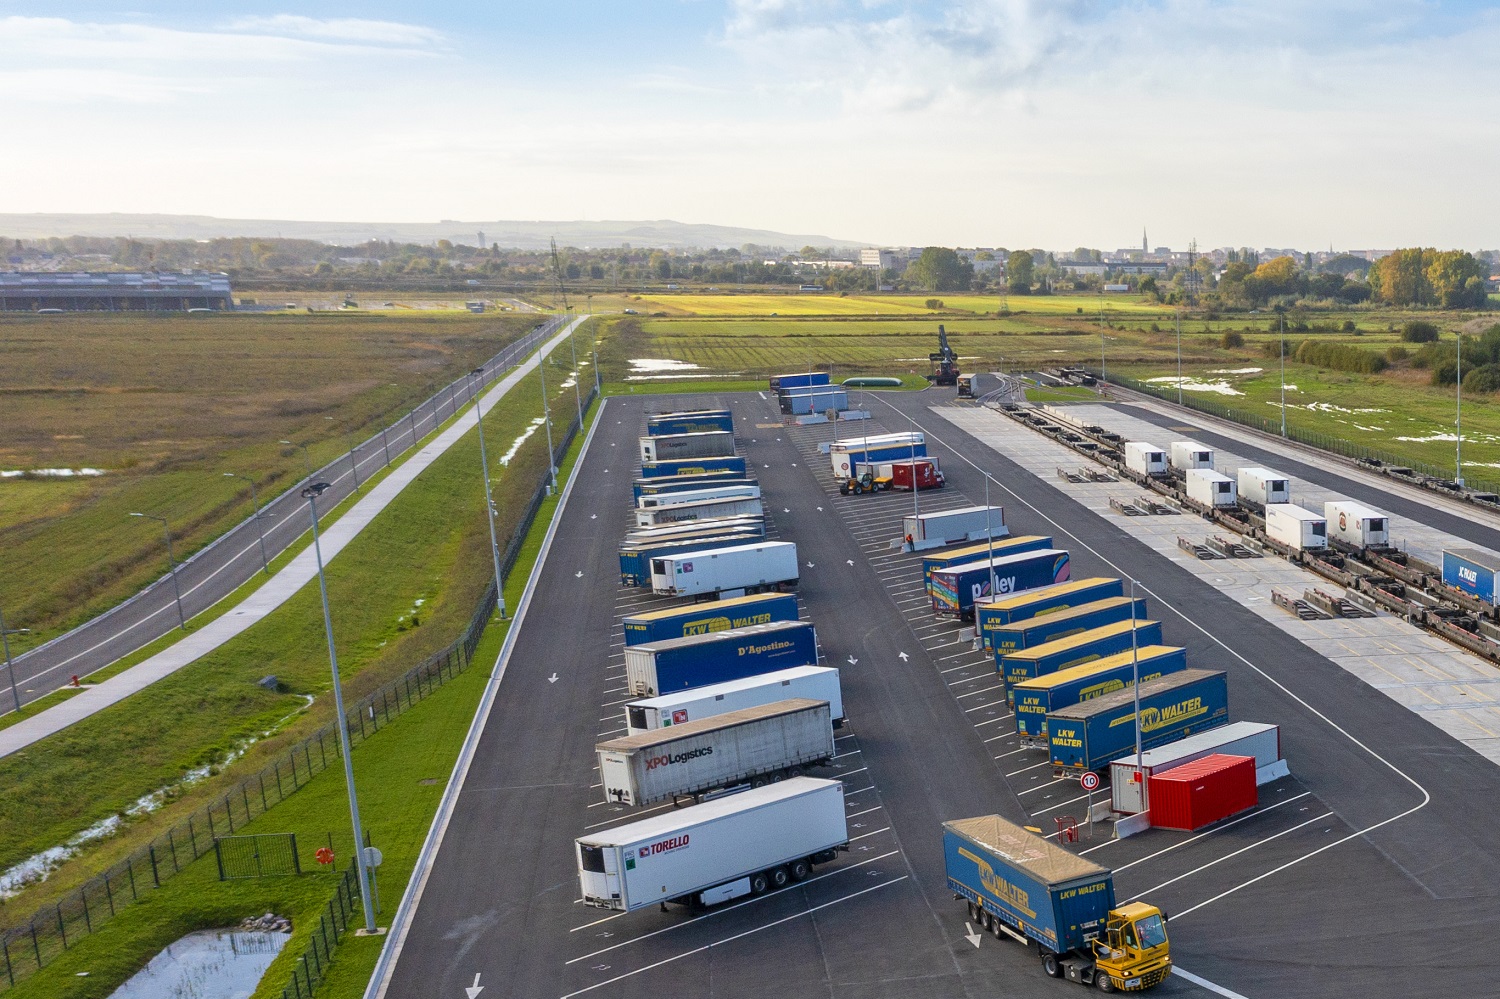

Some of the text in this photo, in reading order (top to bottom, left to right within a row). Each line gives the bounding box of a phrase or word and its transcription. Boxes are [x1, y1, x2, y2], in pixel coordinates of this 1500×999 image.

[683, 613, 771, 637] LKW WALTER
[738, 641, 790, 656] D'Agostino
[1023, 697, 1040, 705] LKW
[1018, 705, 1046, 714] WALTER
[1161, 697, 1201, 720] WALTER
[1058, 729, 1075, 738] LKW
[1052, 738, 1082, 748] WALTER
[1085, 777, 1095, 785] 10
[651, 834, 690, 855] TORELLO
[1060, 882, 1106, 900] LKW WALTER
